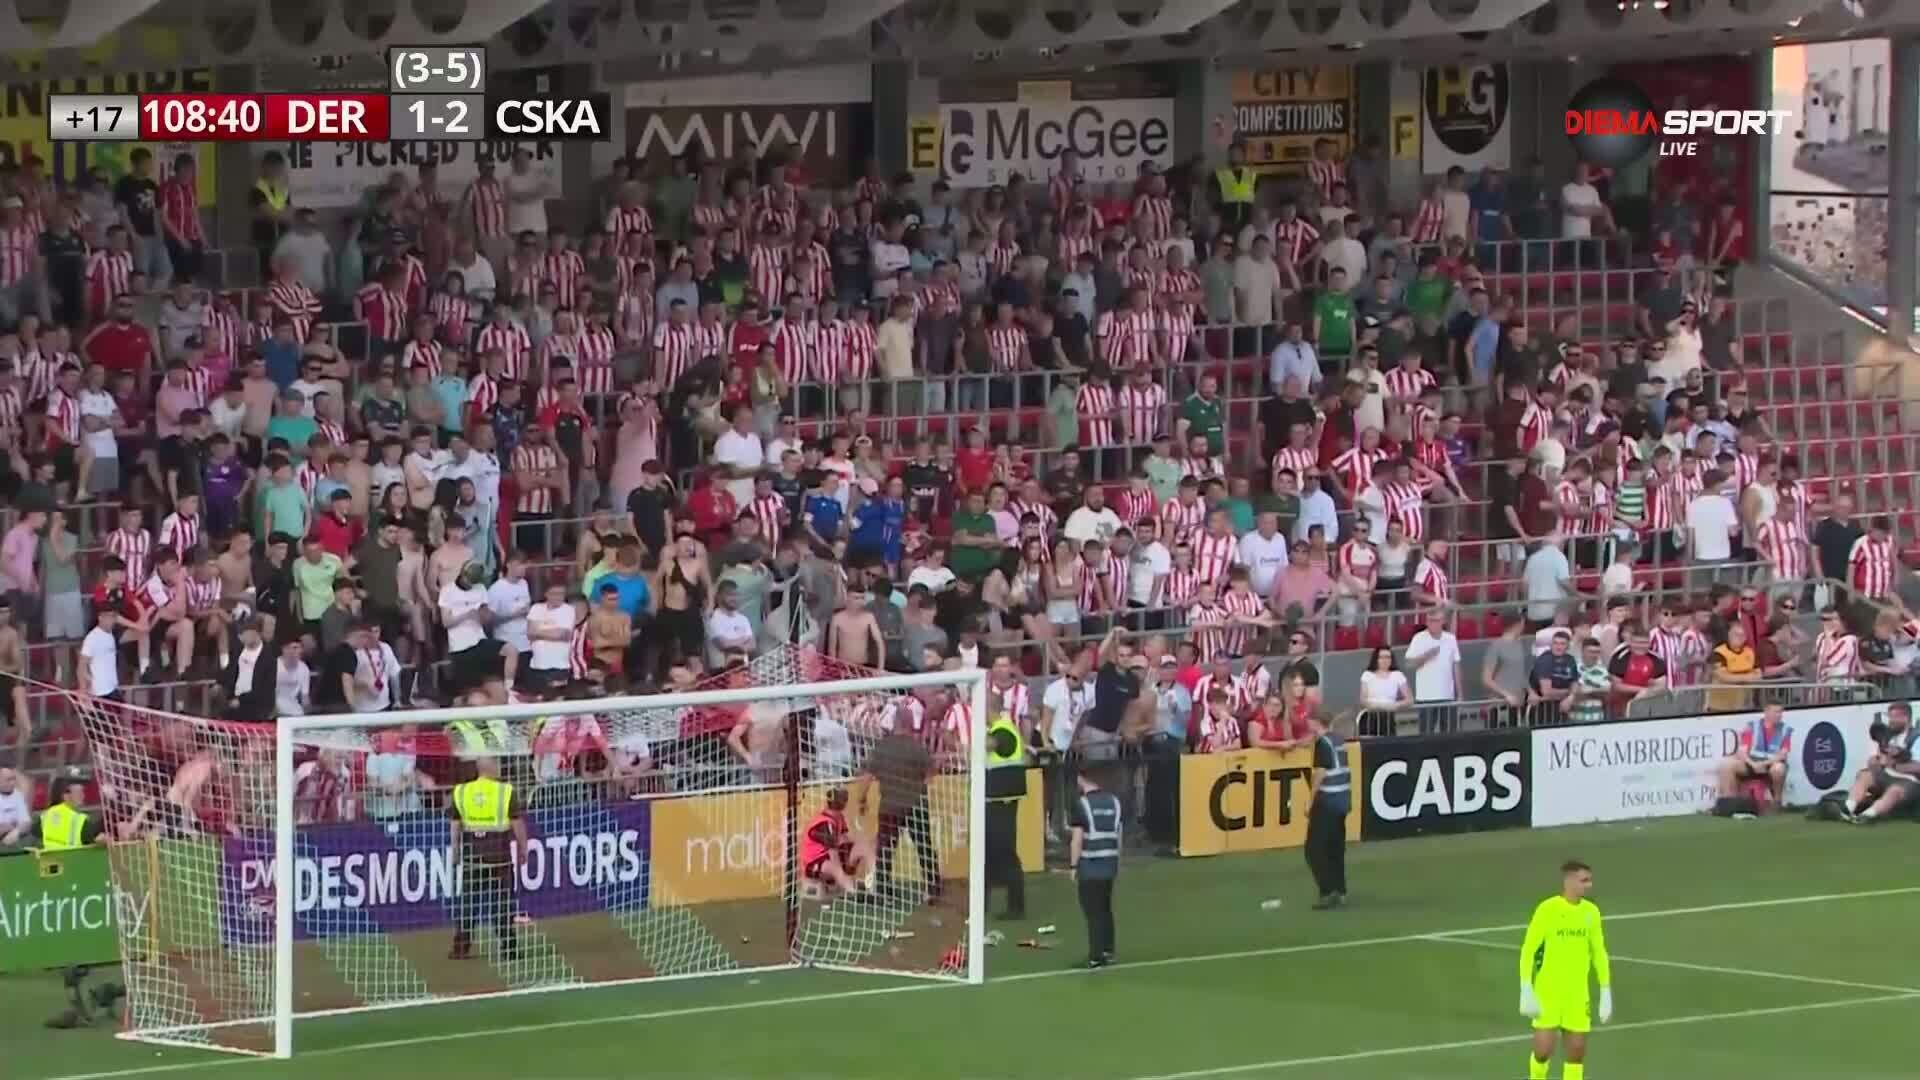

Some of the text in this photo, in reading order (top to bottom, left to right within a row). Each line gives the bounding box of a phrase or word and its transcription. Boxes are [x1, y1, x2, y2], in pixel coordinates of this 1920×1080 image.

[636, 110, 836, 158] MIWI
[911, 126, 936, 168] E
[986, 106, 1168, 160] McGee
[1394, 115, 1415, 154] F
[1370, 751, 1522, 821] CABS
[294, 848, 463, 913] DESMON
